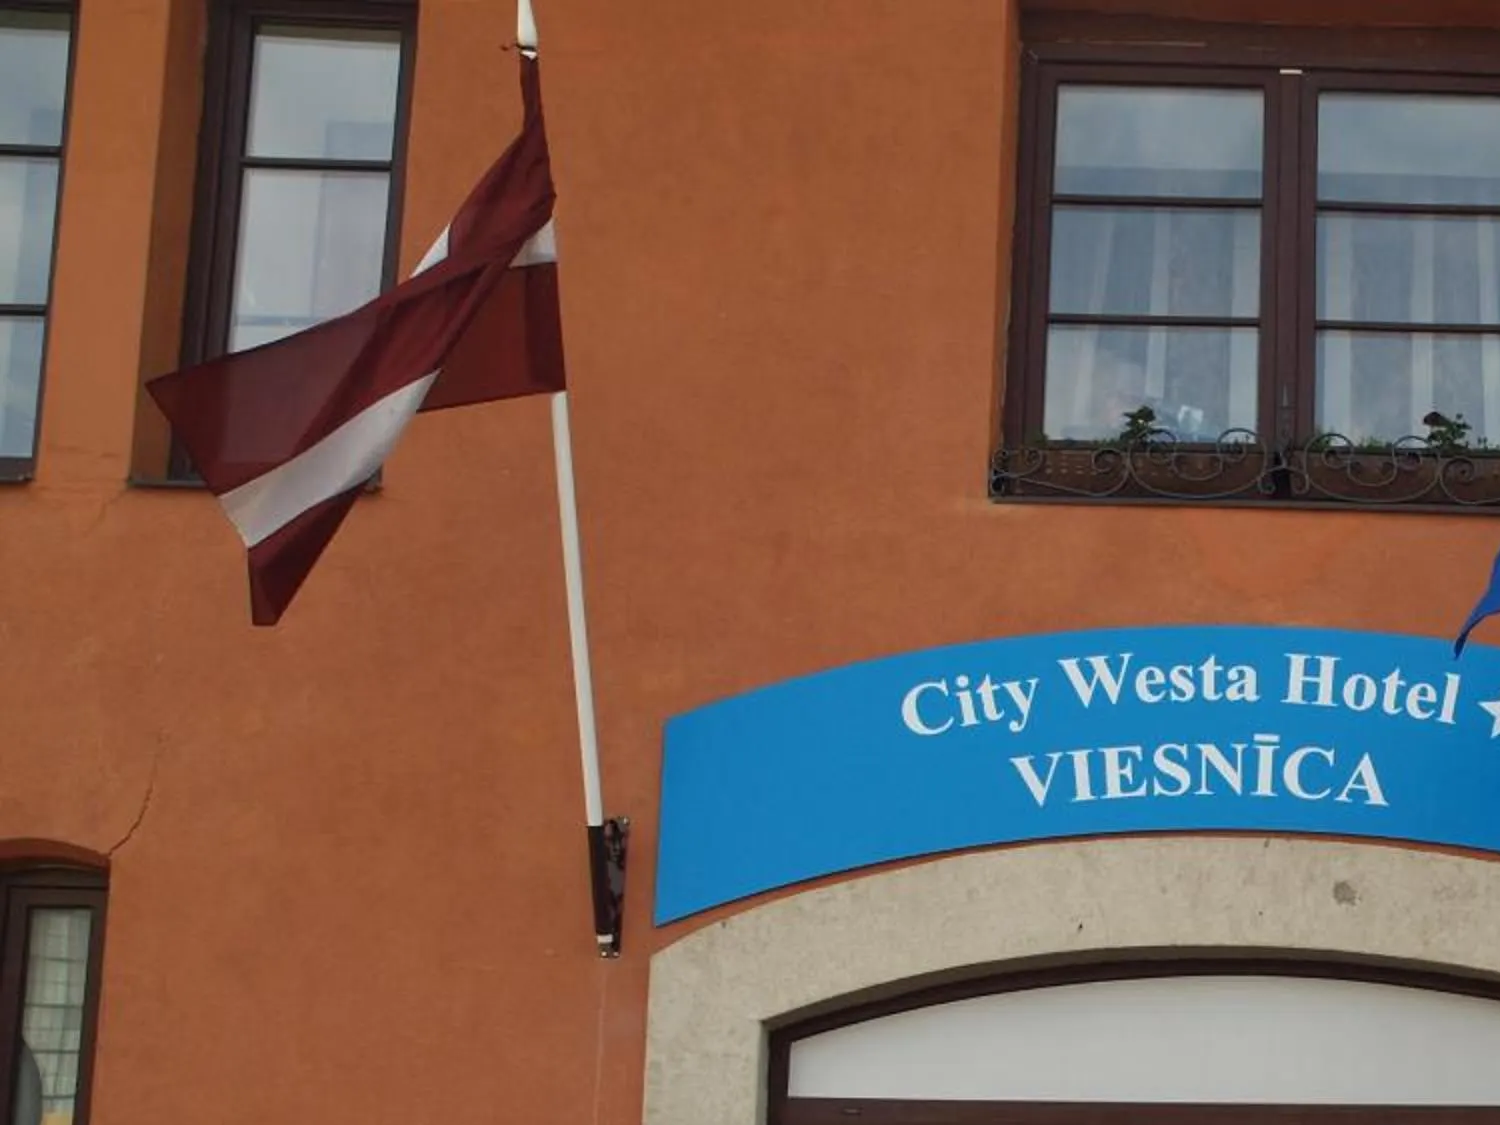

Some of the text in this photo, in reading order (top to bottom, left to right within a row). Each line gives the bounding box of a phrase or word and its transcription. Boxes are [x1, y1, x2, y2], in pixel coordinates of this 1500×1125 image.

[901, 653, 1461, 735] City Westa Hotel
[1010, 733, 1388, 806] VIESNĪCA
